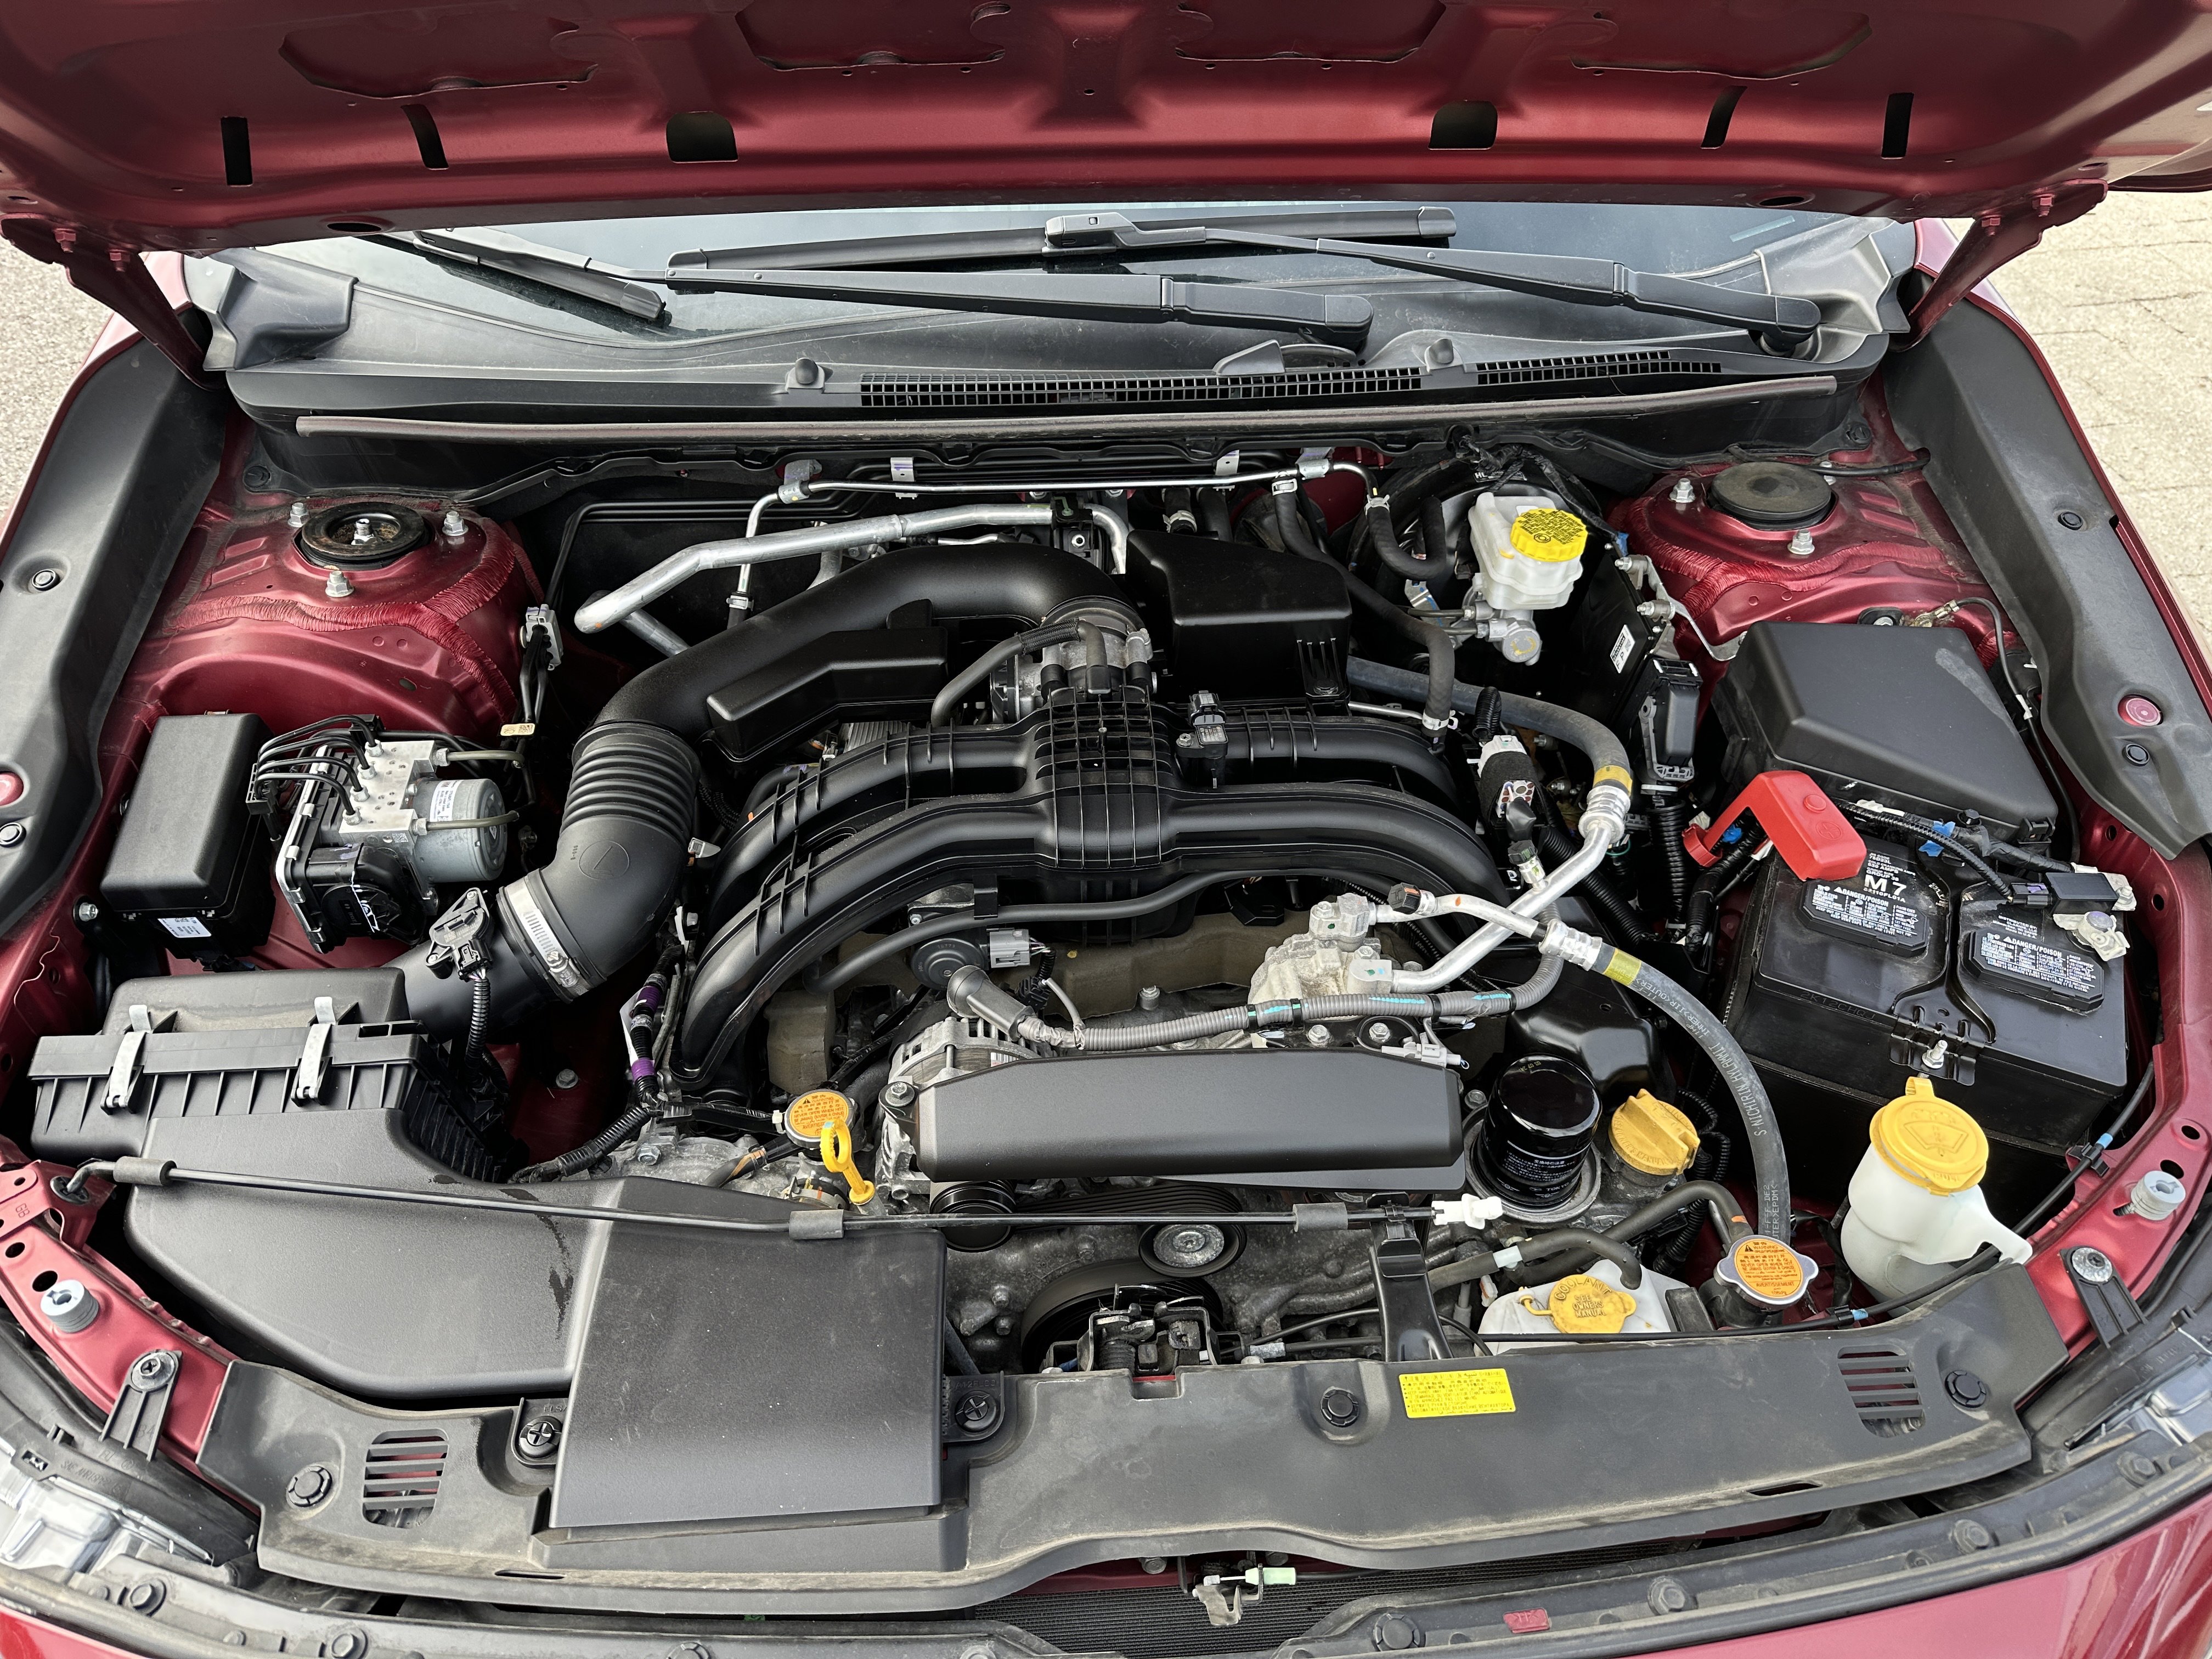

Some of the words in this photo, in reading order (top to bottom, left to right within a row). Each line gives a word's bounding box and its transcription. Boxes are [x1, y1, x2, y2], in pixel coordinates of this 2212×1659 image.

[1866, 870, 1891, 879] GROUP
[1842, 888, 1889, 907] DANGER/POISON
[1997, 915, 2028, 927] DISTRIBUTED
[2011, 938, 2063, 958] DANGER/POISON
[1554, 1277, 1612, 1300] COOLANT
[1575, 1309, 1606, 1318] MANUAL
